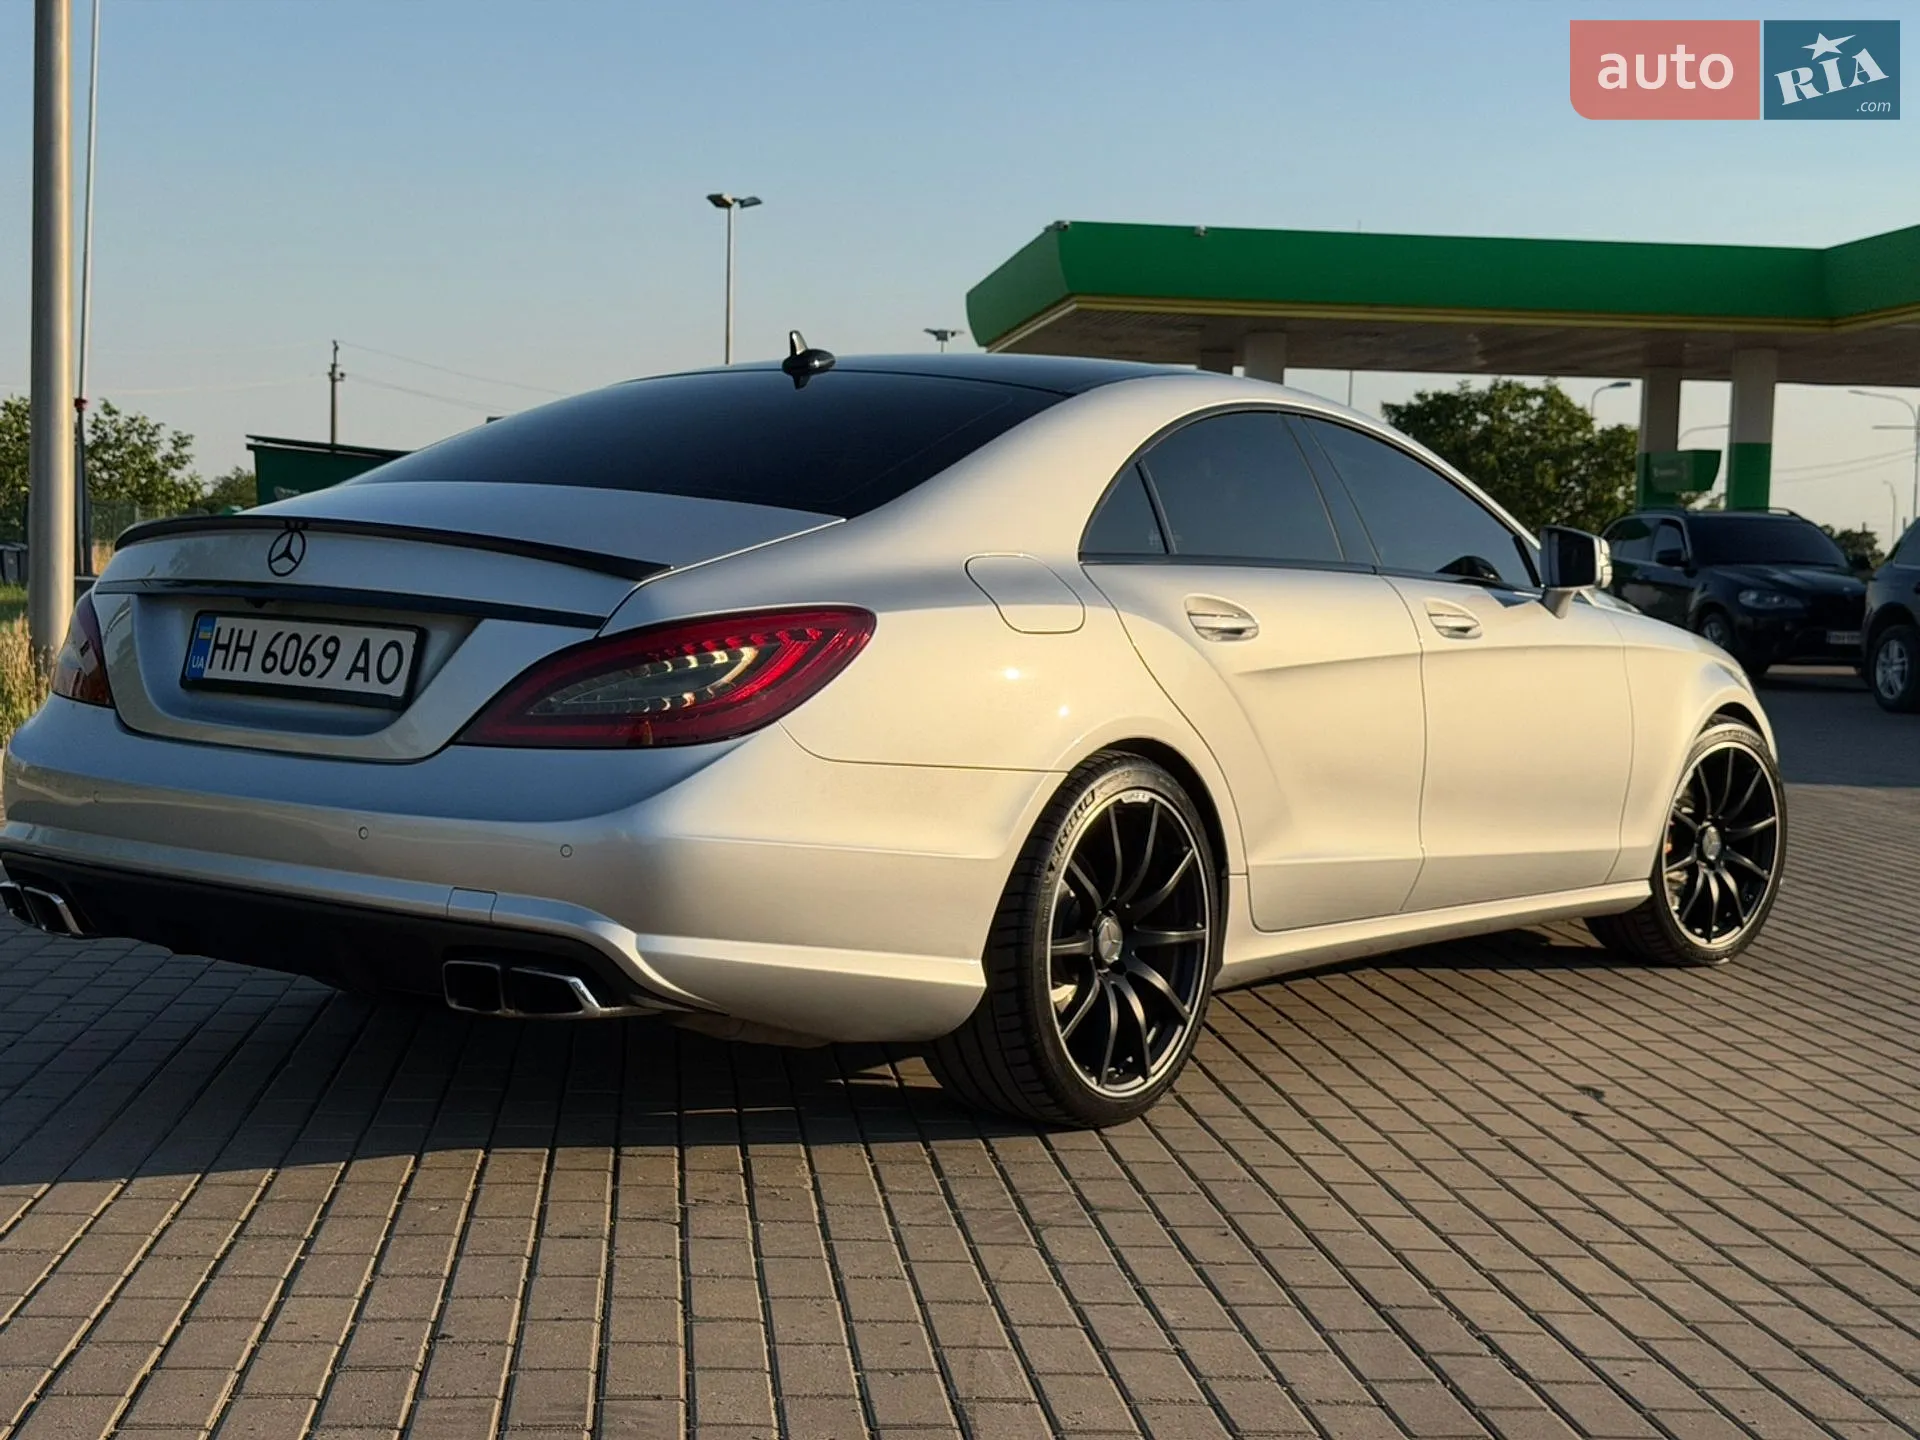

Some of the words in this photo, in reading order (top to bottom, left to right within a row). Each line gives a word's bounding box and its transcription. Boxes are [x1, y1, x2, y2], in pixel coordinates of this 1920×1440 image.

[192, 655, 204, 669] UA
[208, 626, 257, 672] HH
[261, 631, 341, 679] 6069
[345, 638, 404, 685] AO
